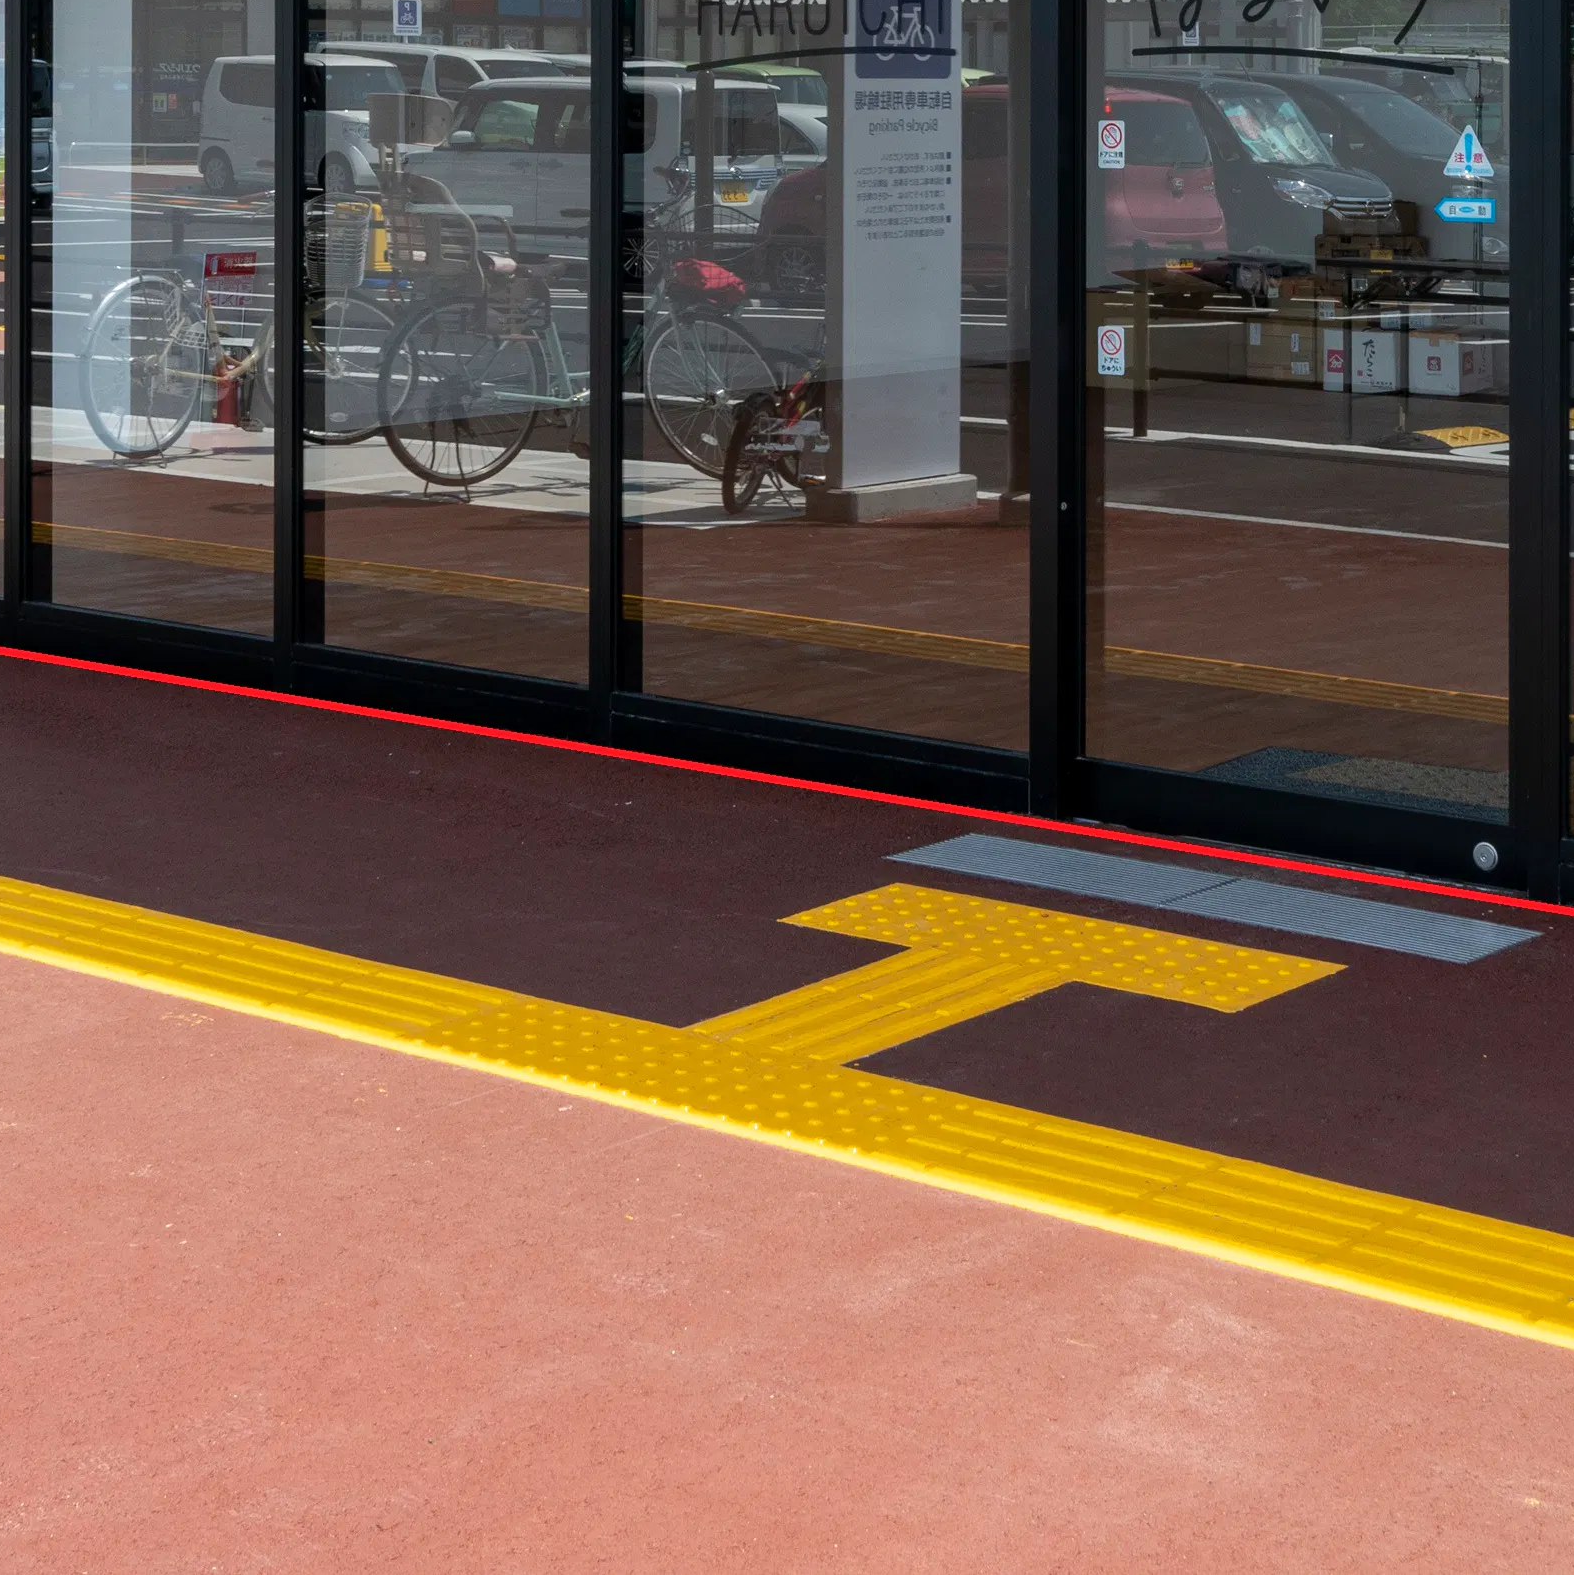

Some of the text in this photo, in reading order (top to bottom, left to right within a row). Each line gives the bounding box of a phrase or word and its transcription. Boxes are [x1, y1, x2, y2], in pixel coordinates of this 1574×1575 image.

[1454, 152, 1484, 163] 注意
[1448, 205, 1487, 217] 自動
[1103, 356, 1120, 364] ドアに
[1361, 337, 1377, 379] たらこ
